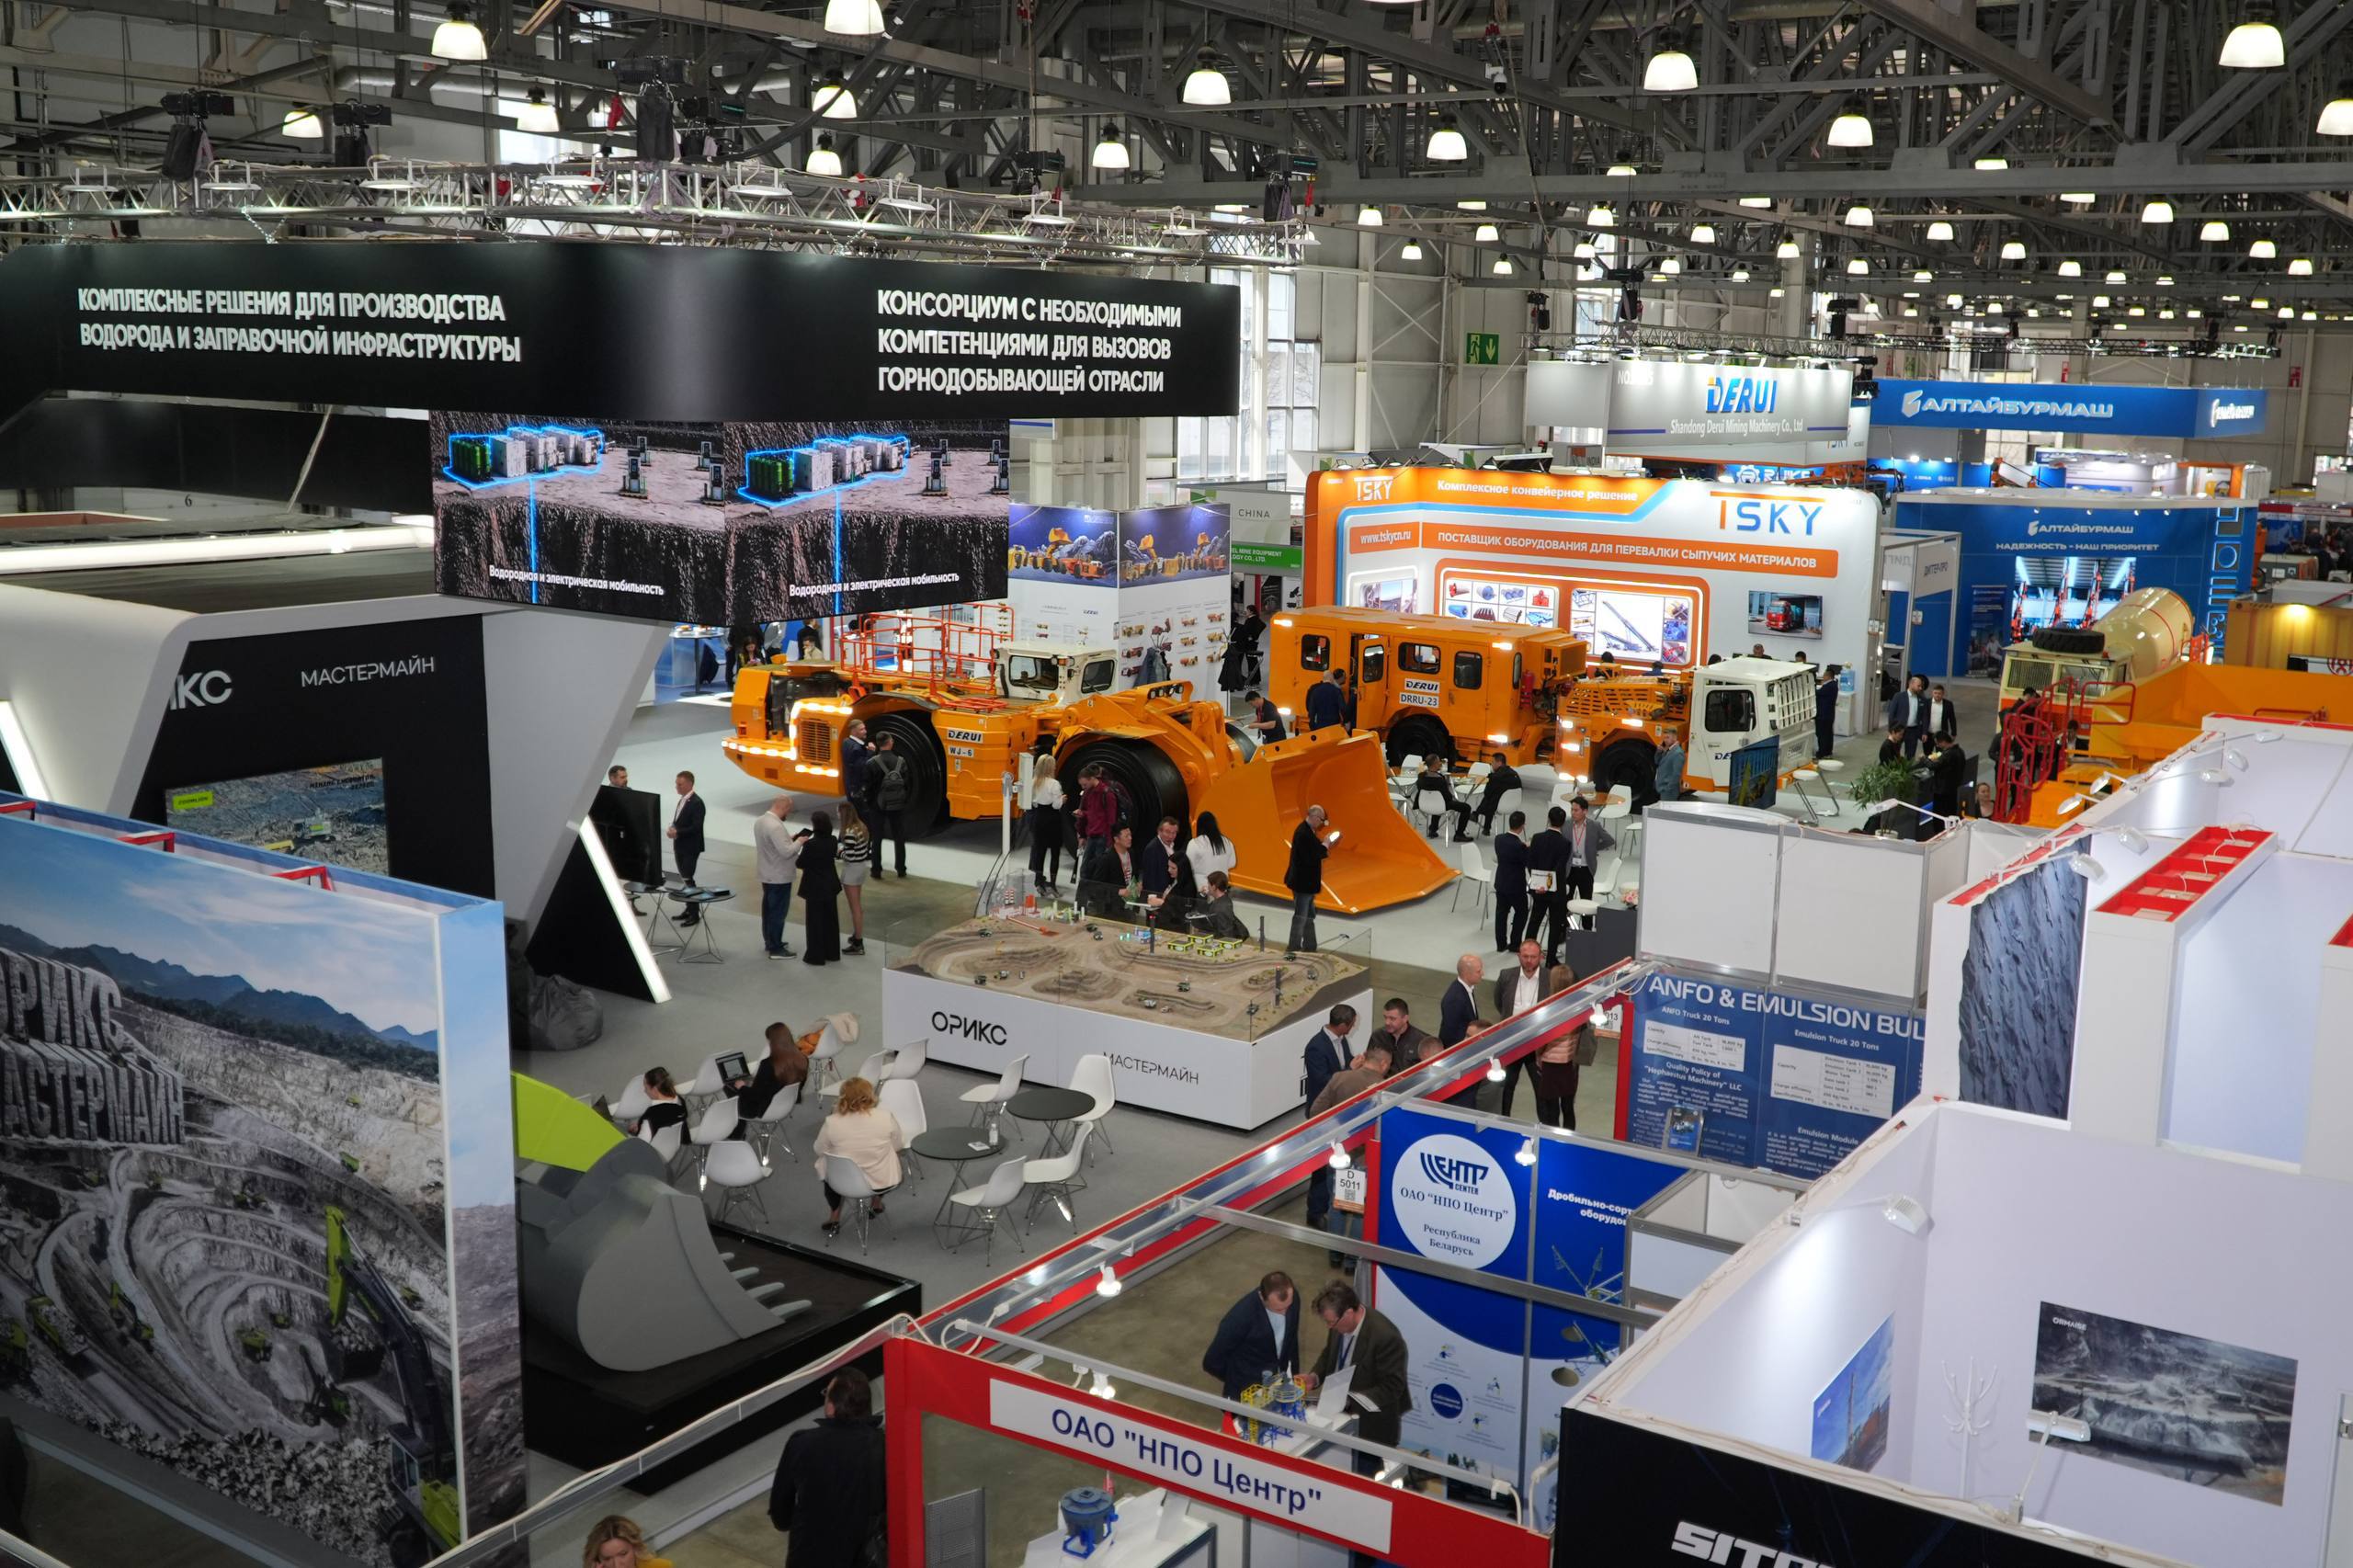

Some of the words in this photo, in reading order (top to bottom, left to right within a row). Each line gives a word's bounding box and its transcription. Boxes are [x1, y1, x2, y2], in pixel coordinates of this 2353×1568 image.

[77, 288, 203, 313] КОМПЛЕКСНЫЕ
[205, 290, 290, 316] РЕШЕНИЯ
[294, 291, 335, 320] ДЛЯ
[339, 292, 506, 324] ПРОИЗВОДСТВА
[877, 290, 1018, 322] КОНСОРЦИУМ
[1021, 297, 1037, 322] С
[1040, 299, 1182, 328] НЕОБХОДИМЫМИ
[79, 323, 174, 352] ВОДОРОДА
[176, 325, 190, 349] И
[193, 324, 329, 356] ЗАПРАВОЧНОЙ
[332, 330, 521, 362] ИНФРАСТРУКТУРЫ
[878, 329, 1049, 358] КОМПЕТЕНЦИЯМИ
[1051, 335, 1088, 360] ДЛЯ
[1092, 336, 1172, 359] ВЫЗОВОВ
[878, 365, 1086, 395] ГОРНОДОБЫВАЮЩЕЙ
[1088, 369, 1165, 392] ОТРАСЛИ
[1705, 375, 1779, 414] DERUI
[1921, 396, 2113, 418] АЛТАЙБУРМАШ
[1670, 419, 1706, 437] Shandong
[1706, 419, 1725, 434] Derui
[1725, 419, 1748, 437] Mining
[1748, 418, 1781, 436] Machinery
[1781, 420, 1792, 434] Co.,
[1793, 418, 1803, 432] Ltd
[1353, 475, 1394, 501] TSKY
[1438, 480, 1509, 494] Комплексное
[1511, 485, 1584, 500] конвейерное
[1586, 490, 1638, 502] решение
[185, 494, 192, 507] 6
[1238, 508, 1270, 517] CHINA
[1710, 490, 1825, 536] TSKY
[1360, 530, 1412, 545] www.tskycn.ru
[2039, 524, 2133, 534] АЛТАЙБУРМАШ
[1252, 549, 1282, 557] EQUIPMENT
[1438, 532, 1502, 547] ПОСТАВЩИК
[1504, 537, 1587, 551] ОБОРУДОВАНИЯ
[1589, 540, 1613, 553] ДЛЯ
[1615, 544, 1679, 559] ПЕРЕВАЛКИ
[1681, 549, 1736, 562] СЫПУЧИХ
[1739, 554, 1817, 569] МАТЕРИАЛОВ
[489, 564, 540, 582] Водородная
[539, 572, 546, 582] и
[545, 573, 608, 590] электрическая
[608, 580, 665, 596] мобильность
[789, 582, 843, 597] Водородная
[843, 584, 850, 592] и
[850, 575, 911, 592] электрическая
[911, 572, 960, 585] мобильность
[301, 654, 435, 687] МАСТЕРМАЙН
[1406, 681, 1438, 690] DERUI
[1401, 694, 1438, 706] DRRU-23
[949, 730, 982, 742] DERUI
[1648, 975, 1713, 1004] ANFO
[1719, 988, 1735, 1007] &
[1741, 992, 1870, 1031] EMULSION
[1661, 1006, 1681, 1016] ANFO
[1682, 1010, 1700, 1020] Truck
[1713, 1016, 1730, 1025] Tons
[932, 1011, 1007, 1046] ОРИКС
[1794, 1028, 1827, 1041] Emulsion
[1828, 1035, 1848, 1046] Truck
[1849, 1040, 1860, 1048] 20
[1861, 1041, 1880, 1051] Tons
[1103, 1051, 1199, 1085] МАСТЕРМАЙН
[1665, 1062, 1690, 1074] Quality
[1691, 1066, 1711, 1078] Policy
[1729, 1083, 1742, 1091] LLC
[1798, 1127, 1829, 1140] Emulsion
[1831, 1133, 1859, 1145] Module
[1340, 1179, 1360, 1190] 5011
[1347, 1171, 1354, 1179] D
[1401, 1187, 1426, 1201] ОАО
[1455, 1184, 1479, 1195] CENTER
[1424, 1223, 1481, 1244] Республика
[1429, 1238, 1474, 1256] Беларусь
[1051, 1409, 1115, 1449] ОАО
[1124, 1430, 1202, 1477] "НПО
[1213, 1459, 1322, 1515] Центр"
[1671, 1521, 1836, 1568] SIT
